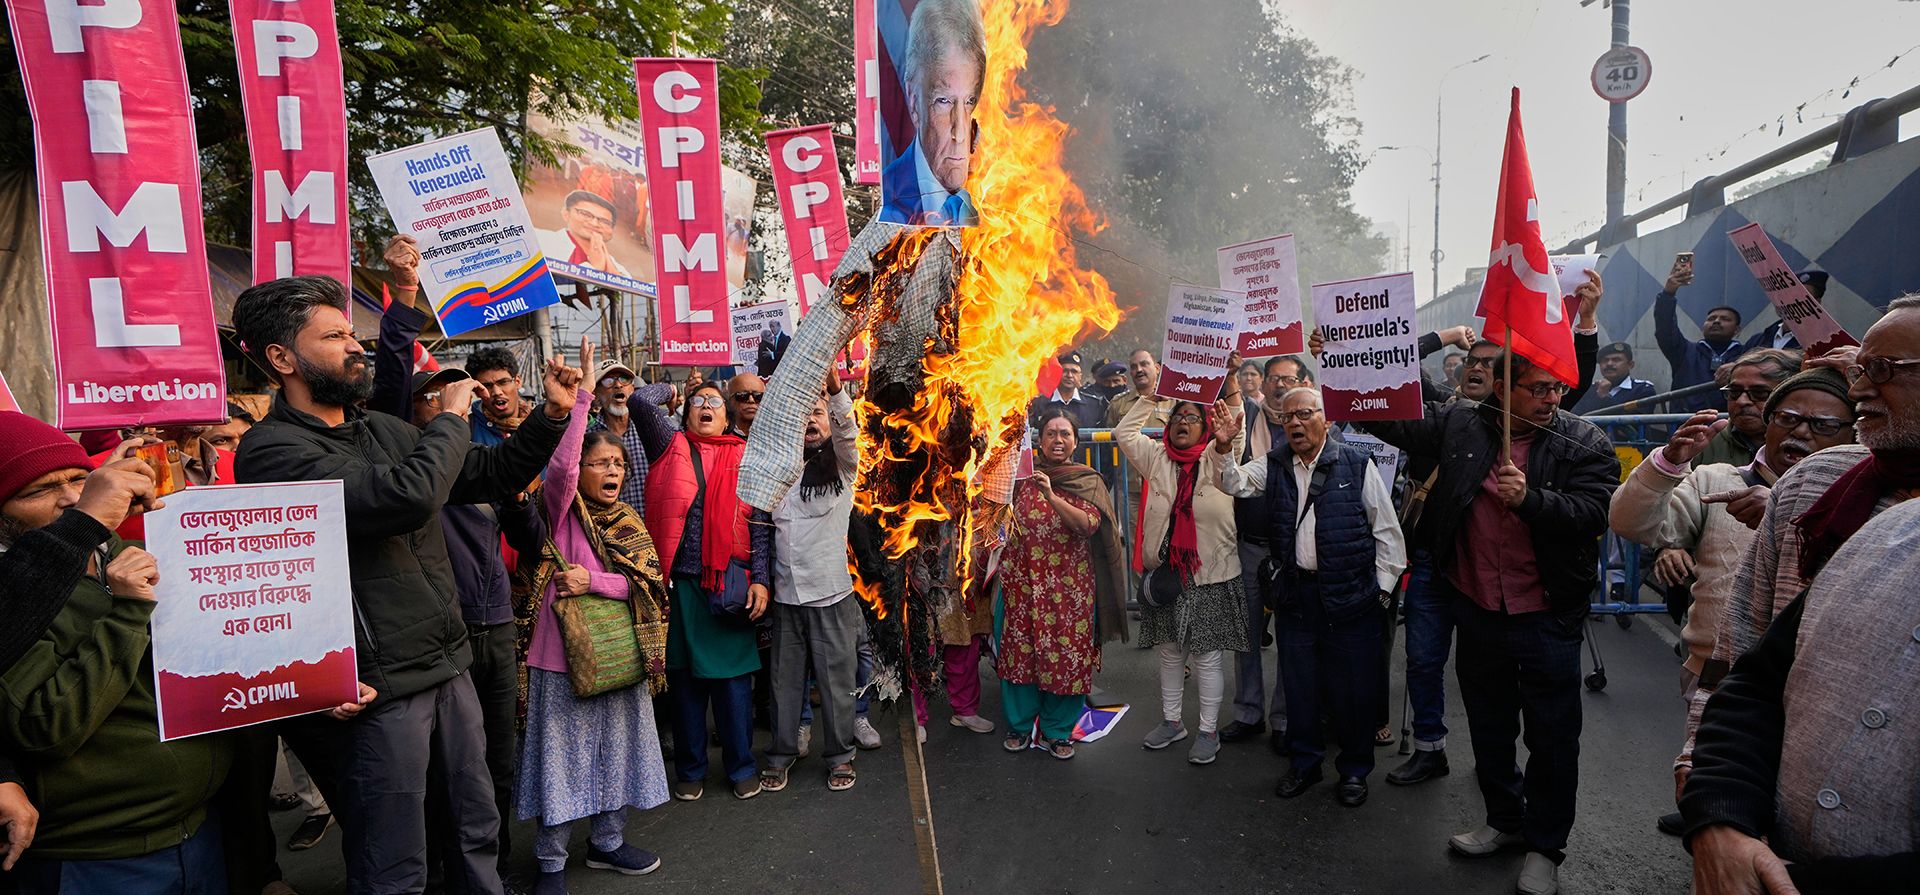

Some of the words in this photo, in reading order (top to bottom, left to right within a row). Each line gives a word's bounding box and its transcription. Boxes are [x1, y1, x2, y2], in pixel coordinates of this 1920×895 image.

[1606, 66, 1638, 82] 40
[1607, 83, 1632, 92] Km/h
[252, 0, 335, 277] PIM
[577, 125, 644, 168] সংহ
[405, 152, 451, 177] Hands
[450, 144, 472, 165] Off
[44, 0, 188, 347] PIML
[408, 163, 486, 196] Venezuela!
[422, 197, 448, 213] মার্কিন
[653, 71, 718, 323] CPIML
[412, 212, 457, 232] ভেনেজুয়েলা
[457, 207, 476, 221] থেকে
[476, 203, 492, 216] হাত
[492, 197, 511, 211] ওঠাও
[782, 136, 830, 307] CPI
[421, 247, 444, 261] মার্কিন
[503, 225, 525, 240] মিছিল
[439, 228, 468, 242] বিক্ষোভ
[467, 220, 493, 236] সমাবেশ
[493, 219, 498, 228] ও
[548, 259, 570, 273] rtesy
[586, 269, 606, 281] North
[607, 274, 631, 287] Kolkata
[632, 281, 654, 293] District
[1246, 286, 1278, 299] পরাধমূলক
[1335, 288, 1389, 313] Defend
[497, 297, 529, 317] CPIML
[1213, 305, 1226, 314] Syria
[1171, 315, 1184, 324] and
[1184, 318, 1198, 326] now
[1199, 317, 1234, 331] Venezuela!
[1321, 316, 1410, 342] Venezuela's
[664, 340, 728, 353] Liberation
[1168, 329, 1192, 345] Down
[1194, 333, 1214, 348] with
[1216, 336, 1233, 351] U.S.
[1257, 336, 1278, 348] CPIML
[1170, 347, 1226, 368] imperialism!
[1321, 344, 1415, 370] Sovereignty!
[68, 377, 217, 404] Liberation
[1185, 382, 1201, 393] CPIML
[1362, 398, 1389, 410] CPIML
[180, 506, 283, 531] ভেনেজুয়েলার
[286, 504, 318, 523] তেল
[184, 532, 235, 557] মার্কিন
[238, 528, 316, 553] বহুজাতিক
[189, 563, 243, 585] সংস্থার
[245, 561, 281, 580] হাতে
[283, 557, 315, 582] তুলে
[198, 590, 257, 611] দেওয়ার
[259, 583, 312, 605] বিরুদ্ধে
[222, 617, 250, 636] এক
[253, 612, 292, 633] হোন।
[248, 681, 299, 705] CPIML
